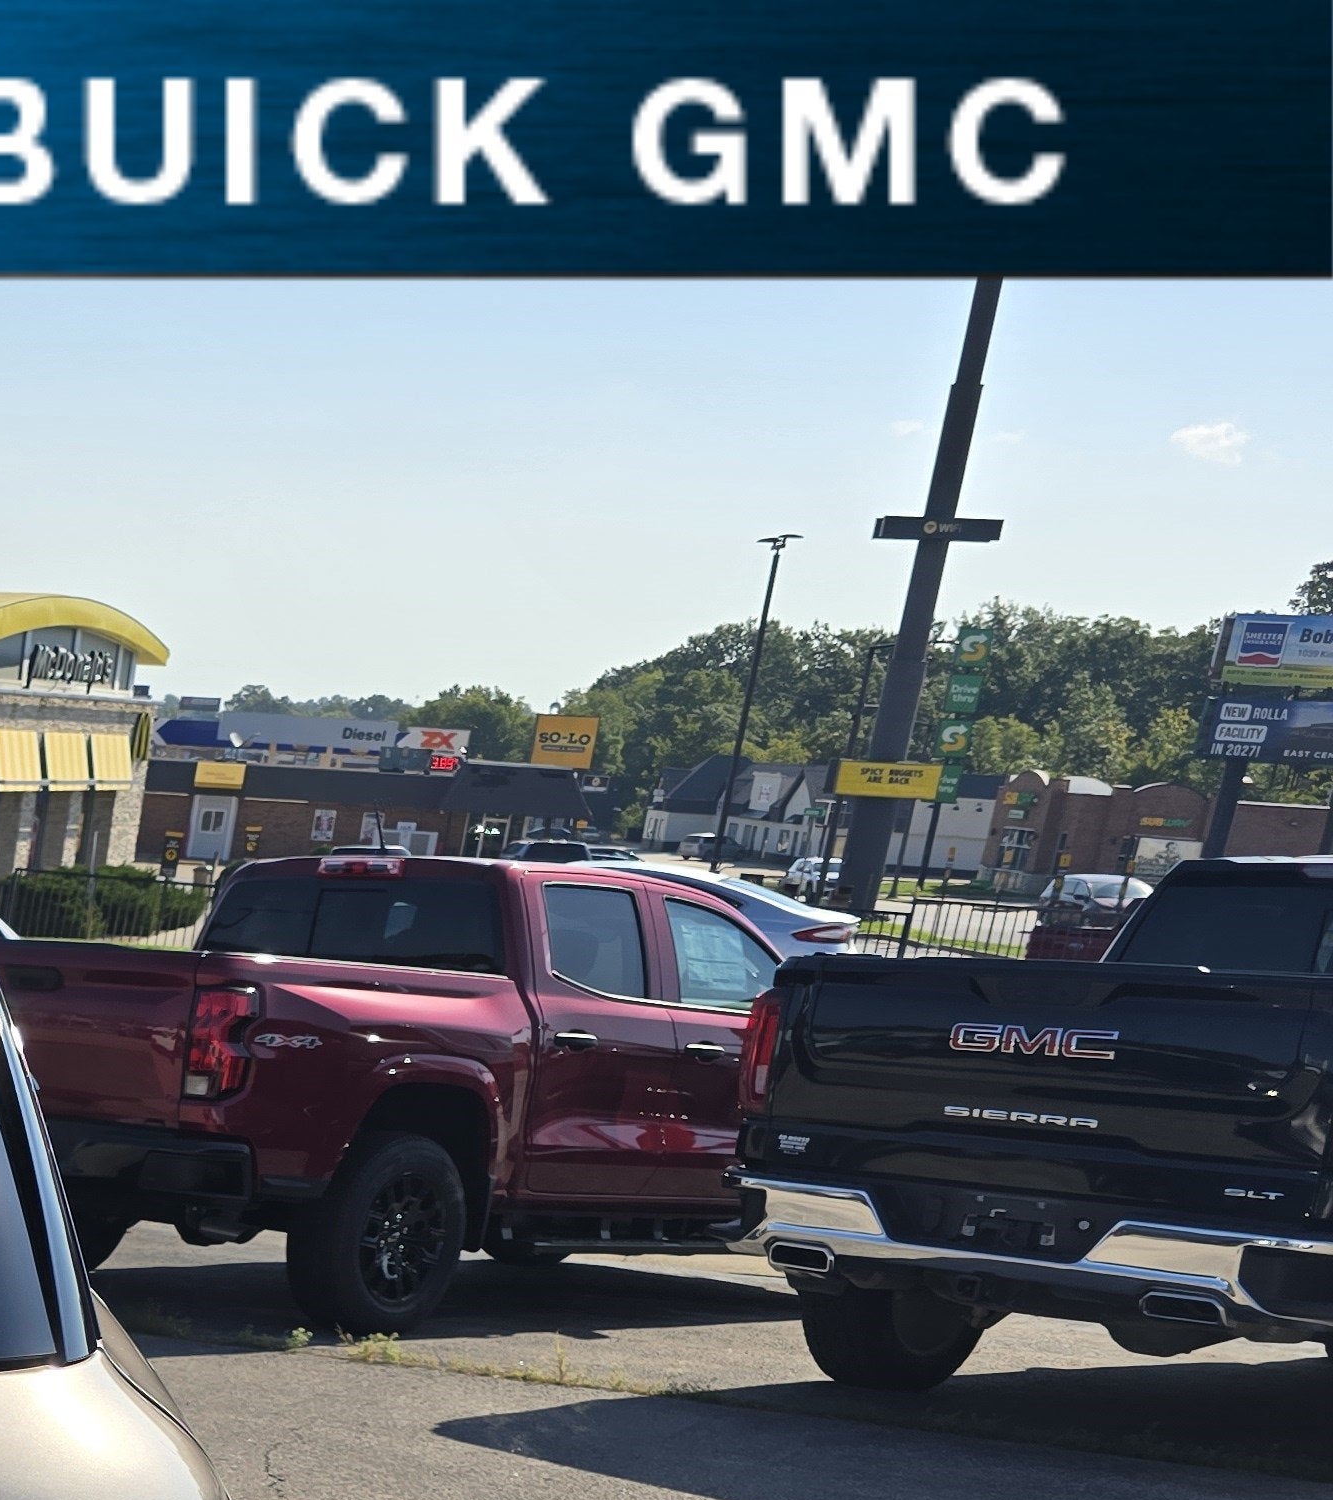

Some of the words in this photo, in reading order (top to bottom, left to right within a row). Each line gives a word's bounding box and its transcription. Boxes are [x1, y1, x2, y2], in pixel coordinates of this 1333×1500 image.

[1245, 631, 1284, 640] SHELTER
[951, 684, 980, 695] Drive
[951, 693, 977, 704] thru
[1223, 705, 1249, 718] NEW
[1253, 708, 1288, 720] ROLLA
[342, 727, 387, 742] Diesel
[538, 732, 591, 745] SO-LO
[1218, 726, 1265, 739] FACILITY
[1211, 743, 1225, 755] IN
[1225, 744, 1262, 757] 2027!
[1283, 750, 1311, 758] EAST
[861, 767, 884, 776] SPICY
[867, 776, 882, 784] ARE
[889, 777, 910, 785] BACK
[948, 1022, 1120, 1060] GMC
[943, 1105, 1099, 1129] SIERRA
[1224, 1188, 1285, 1201] SLT
